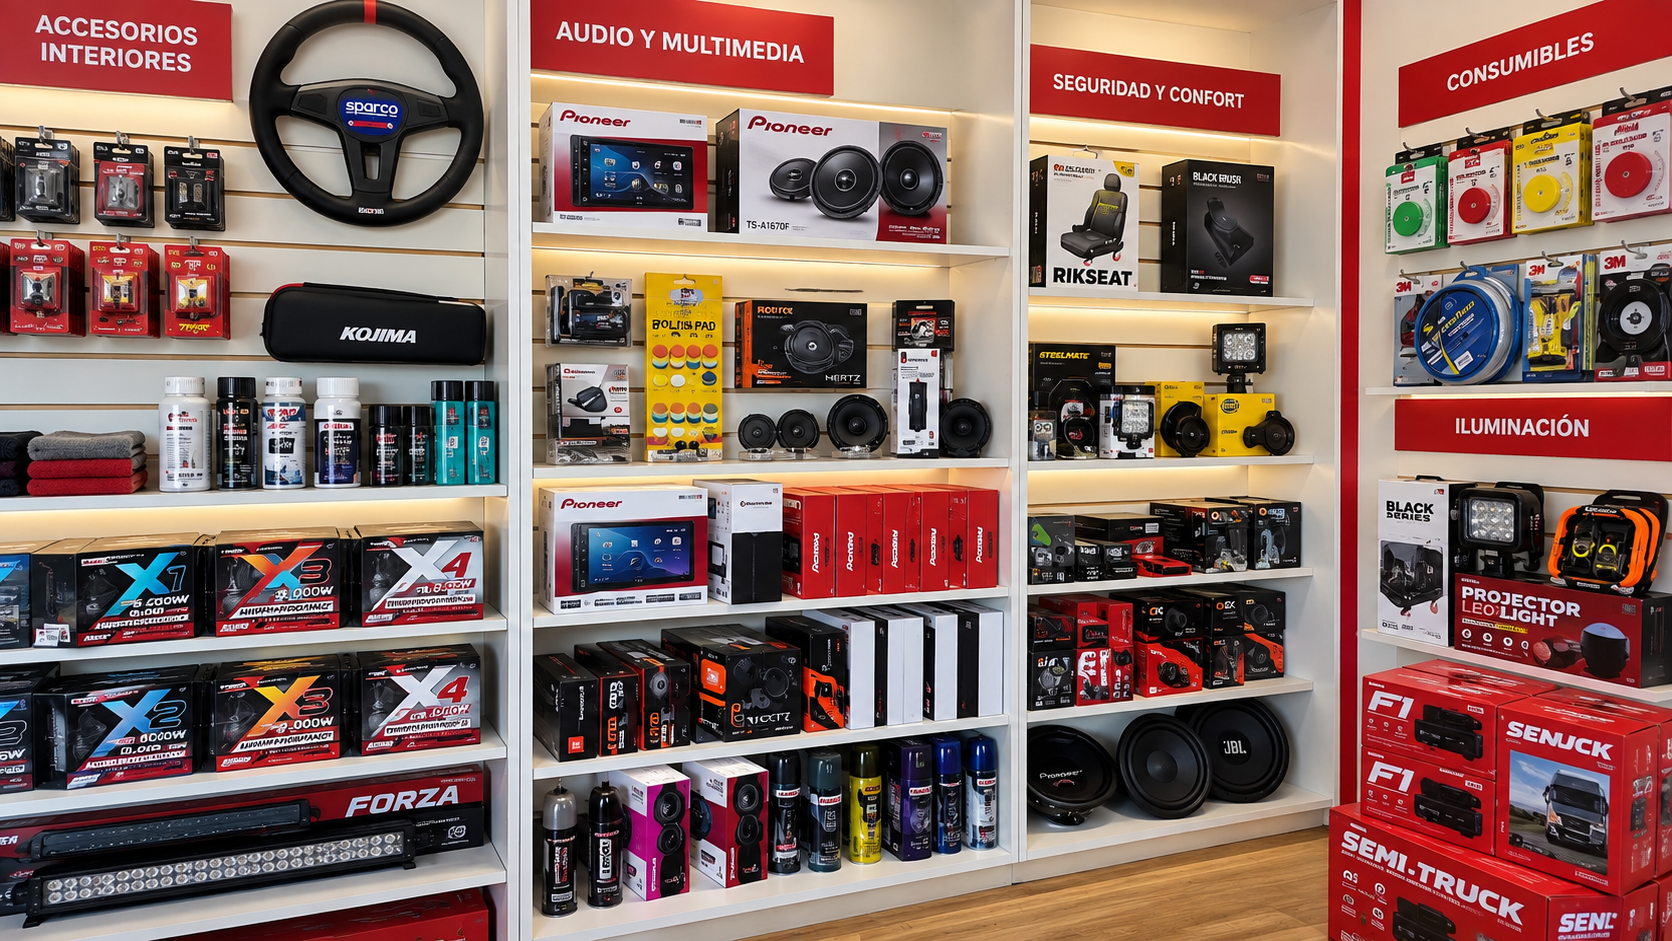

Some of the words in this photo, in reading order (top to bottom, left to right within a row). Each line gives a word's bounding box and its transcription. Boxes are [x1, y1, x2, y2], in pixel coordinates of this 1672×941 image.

[35, 14, 198, 46] ACCESORIOS
[556, 21, 634, 47] AUDIO
[640, 29, 656, 49] Y
[662, 31, 805, 64] MULTIMEDIA
[41, 42, 192, 73] INTERIORES
[1446, 32, 1595, 91] CONSUMIBLES
[1053, 73, 1151, 99] SEGURIDAD
[1155, 84, 1166, 101] Y
[1169, 86, 1245, 109] CONFORT
[345, 100, 399, 116] sparco
[559, 109, 631, 128] Pioneer
[747, 115, 833, 137] Pioneer
[1193, 171, 1218, 184] BLACK
[746, 220, 790, 231] TS-A1670F
[1053, 267, 1133, 287] RIKSEAT
[1603, 255, 1626, 271] 3M
[340, 326, 417, 344] KOJIMA
[694, 320, 717, 332] PAD
[1455, 413, 1590, 438] ILUMINACIÓN
[560, 498, 623, 510] Pioneer
[1386, 500, 1434, 515] BLACK
[229, 541, 332, 620] X3
[371, 539, 473, 612] X4
[1461, 586, 1581, 618] PROJECTOR
[228, 675, 334, 752] X3
[369, 665, 470, 738] X4
[1367, 690, 1415, 719] F1
[90, 688, 187, 758] X2
[1223, 740, 1247, 755] JBL
[1367, 760, 1415, 792] F1
[345, 785, 460, 818] FORZA
